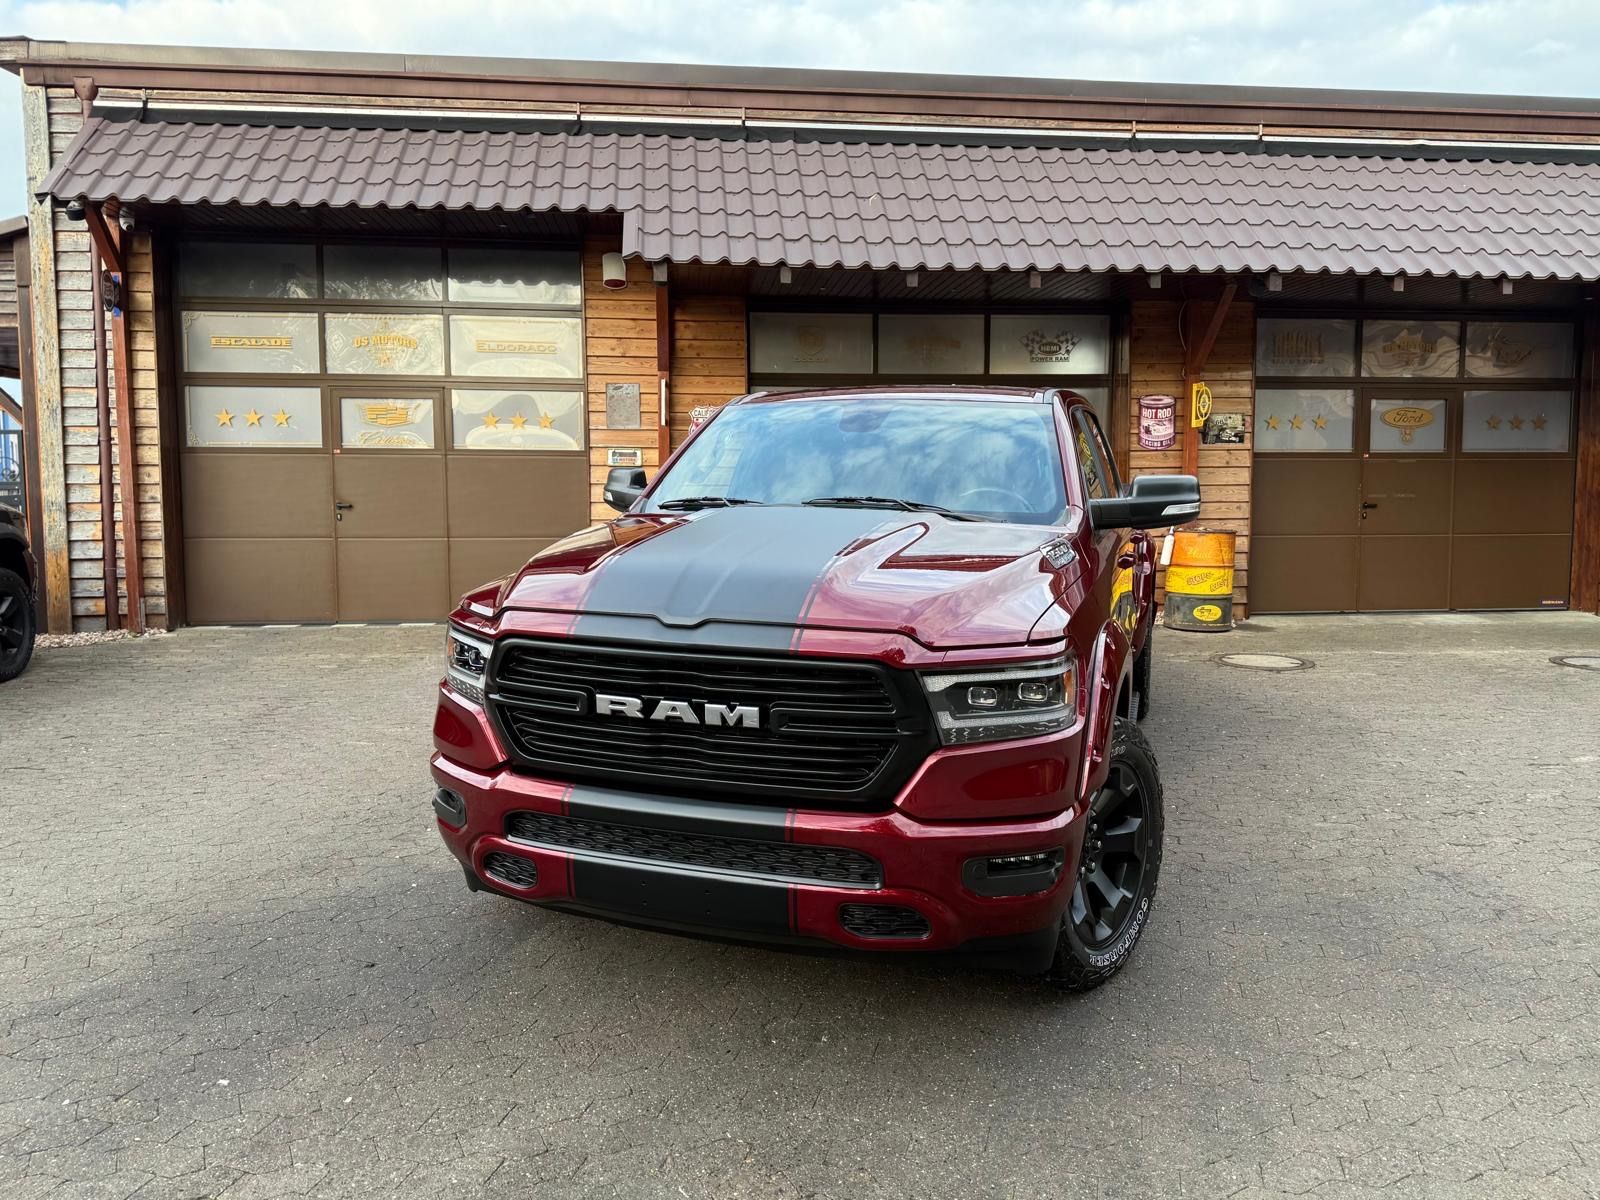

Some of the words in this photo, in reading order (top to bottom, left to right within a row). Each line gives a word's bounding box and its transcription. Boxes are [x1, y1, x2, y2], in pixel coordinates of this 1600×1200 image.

[211, 337, 290, 347] ESCALADE
[372, 335, 417, 349] MOTORS
[476, 342, 557, 353] ELDORADO
[1142, 408, 1156, 419] HOT
[1157, 407, 1172, 419] ROD
[1393, 410, 1424, 423] Ford
[595, 693, 760, 729] RAM
